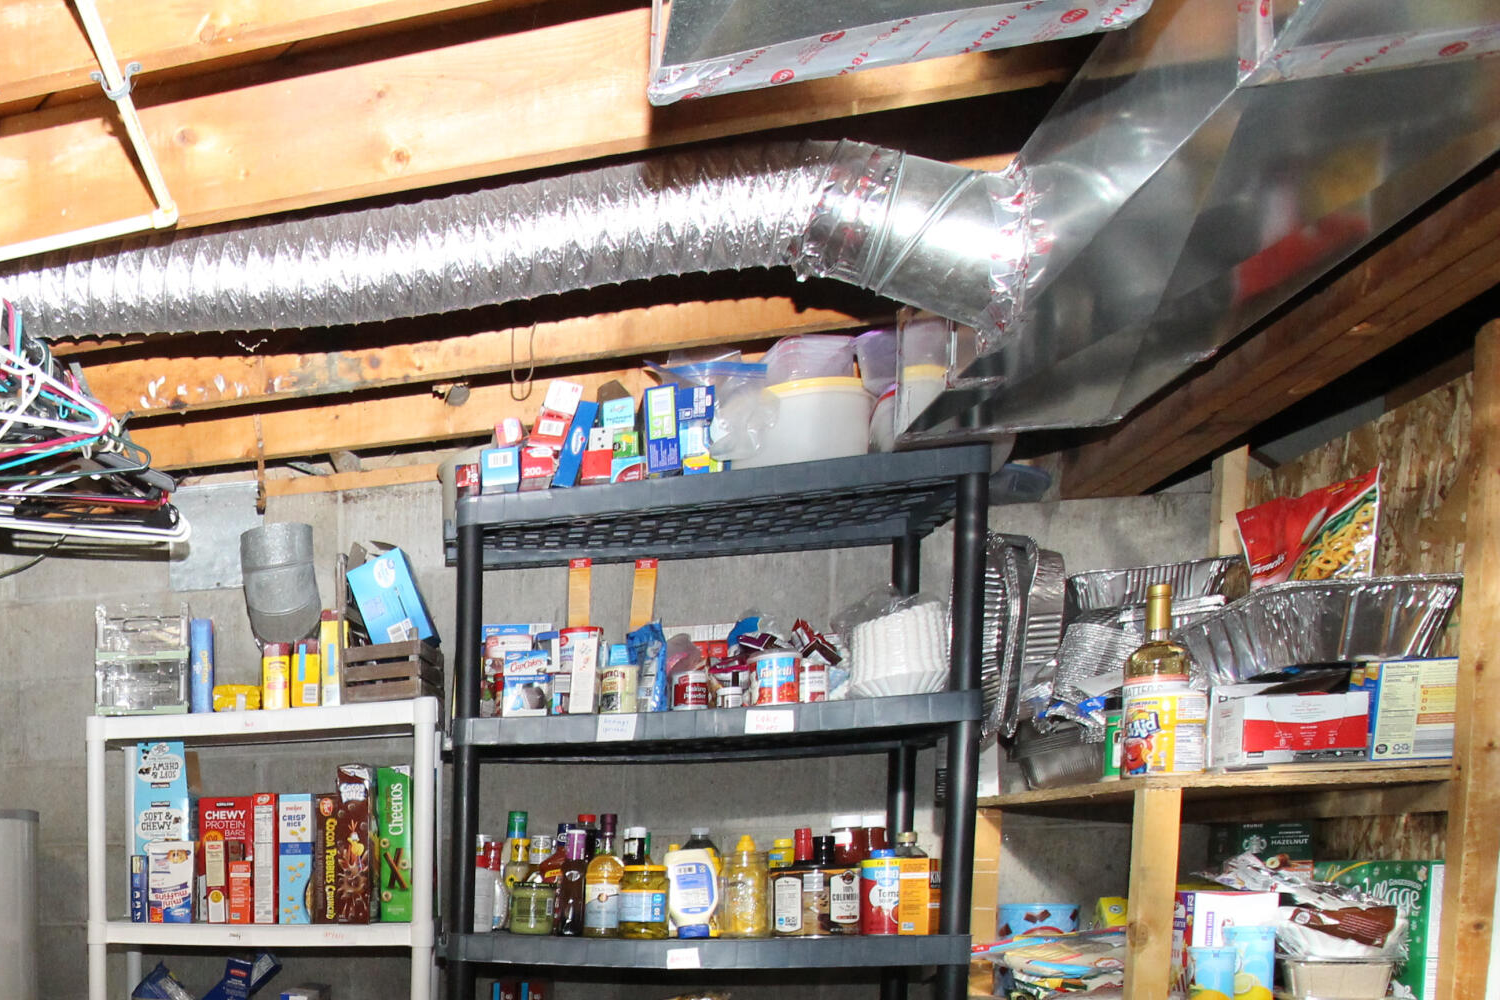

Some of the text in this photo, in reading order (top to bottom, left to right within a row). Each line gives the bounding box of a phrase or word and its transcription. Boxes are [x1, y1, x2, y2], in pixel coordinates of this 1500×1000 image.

[524, 467, 541, 476] 200
[388, 783, 403, 835] Cheerios
[144, 812, 172, 821] SOFT &
[205, 810, 246, 819] CHEWY
[141, 821, 172, 831] CHEWY
[205, 820, 245, 829] PROTEIN
[1271, 838, 1309, 846] HAZELNUT
[1186, 895, 1194, 907] 12
